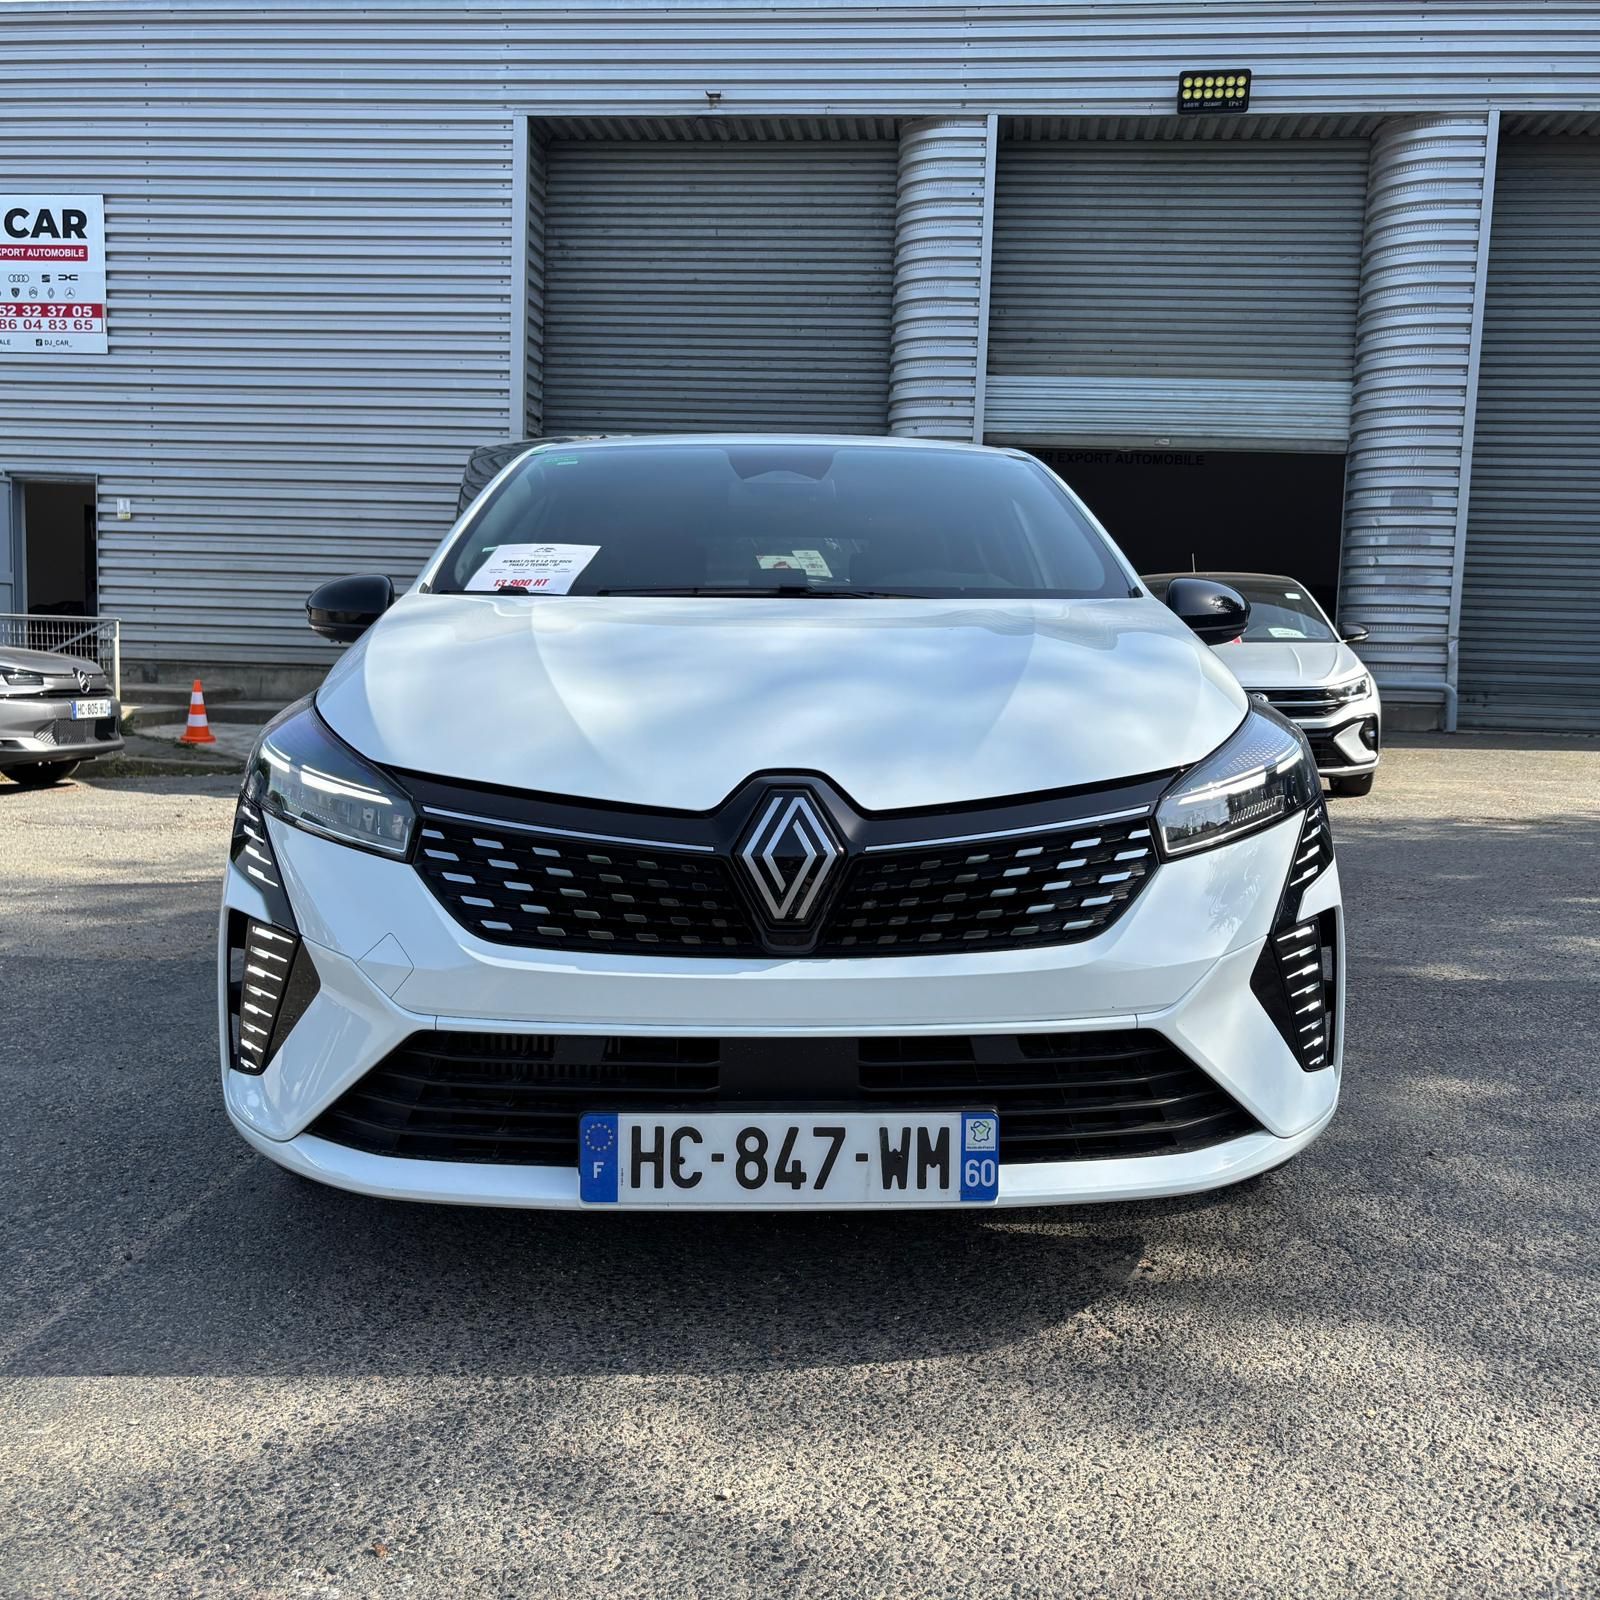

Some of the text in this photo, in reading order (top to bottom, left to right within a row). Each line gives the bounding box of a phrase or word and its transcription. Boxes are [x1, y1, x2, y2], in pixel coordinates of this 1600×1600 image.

[4, 208, 87, 239] CAR
[27, 248, 84, 257] AUTOMOBILE
[0, 305, 93, 317] 52 32 37 05
[0, 319, 93, 331] 86 04 83 65
[1057, 452, 1112, 464] EXPORT
[1115, 453, 1205, 466] AUTOMOBILE
[510, 579, 533, 587] 900
[533, 579, 551, 587] HT
[631, 1126, 950, 1190] HC-847-WM
[593, 1162, 604, 1179] F
[965, 1159, 995, 1188] 60
